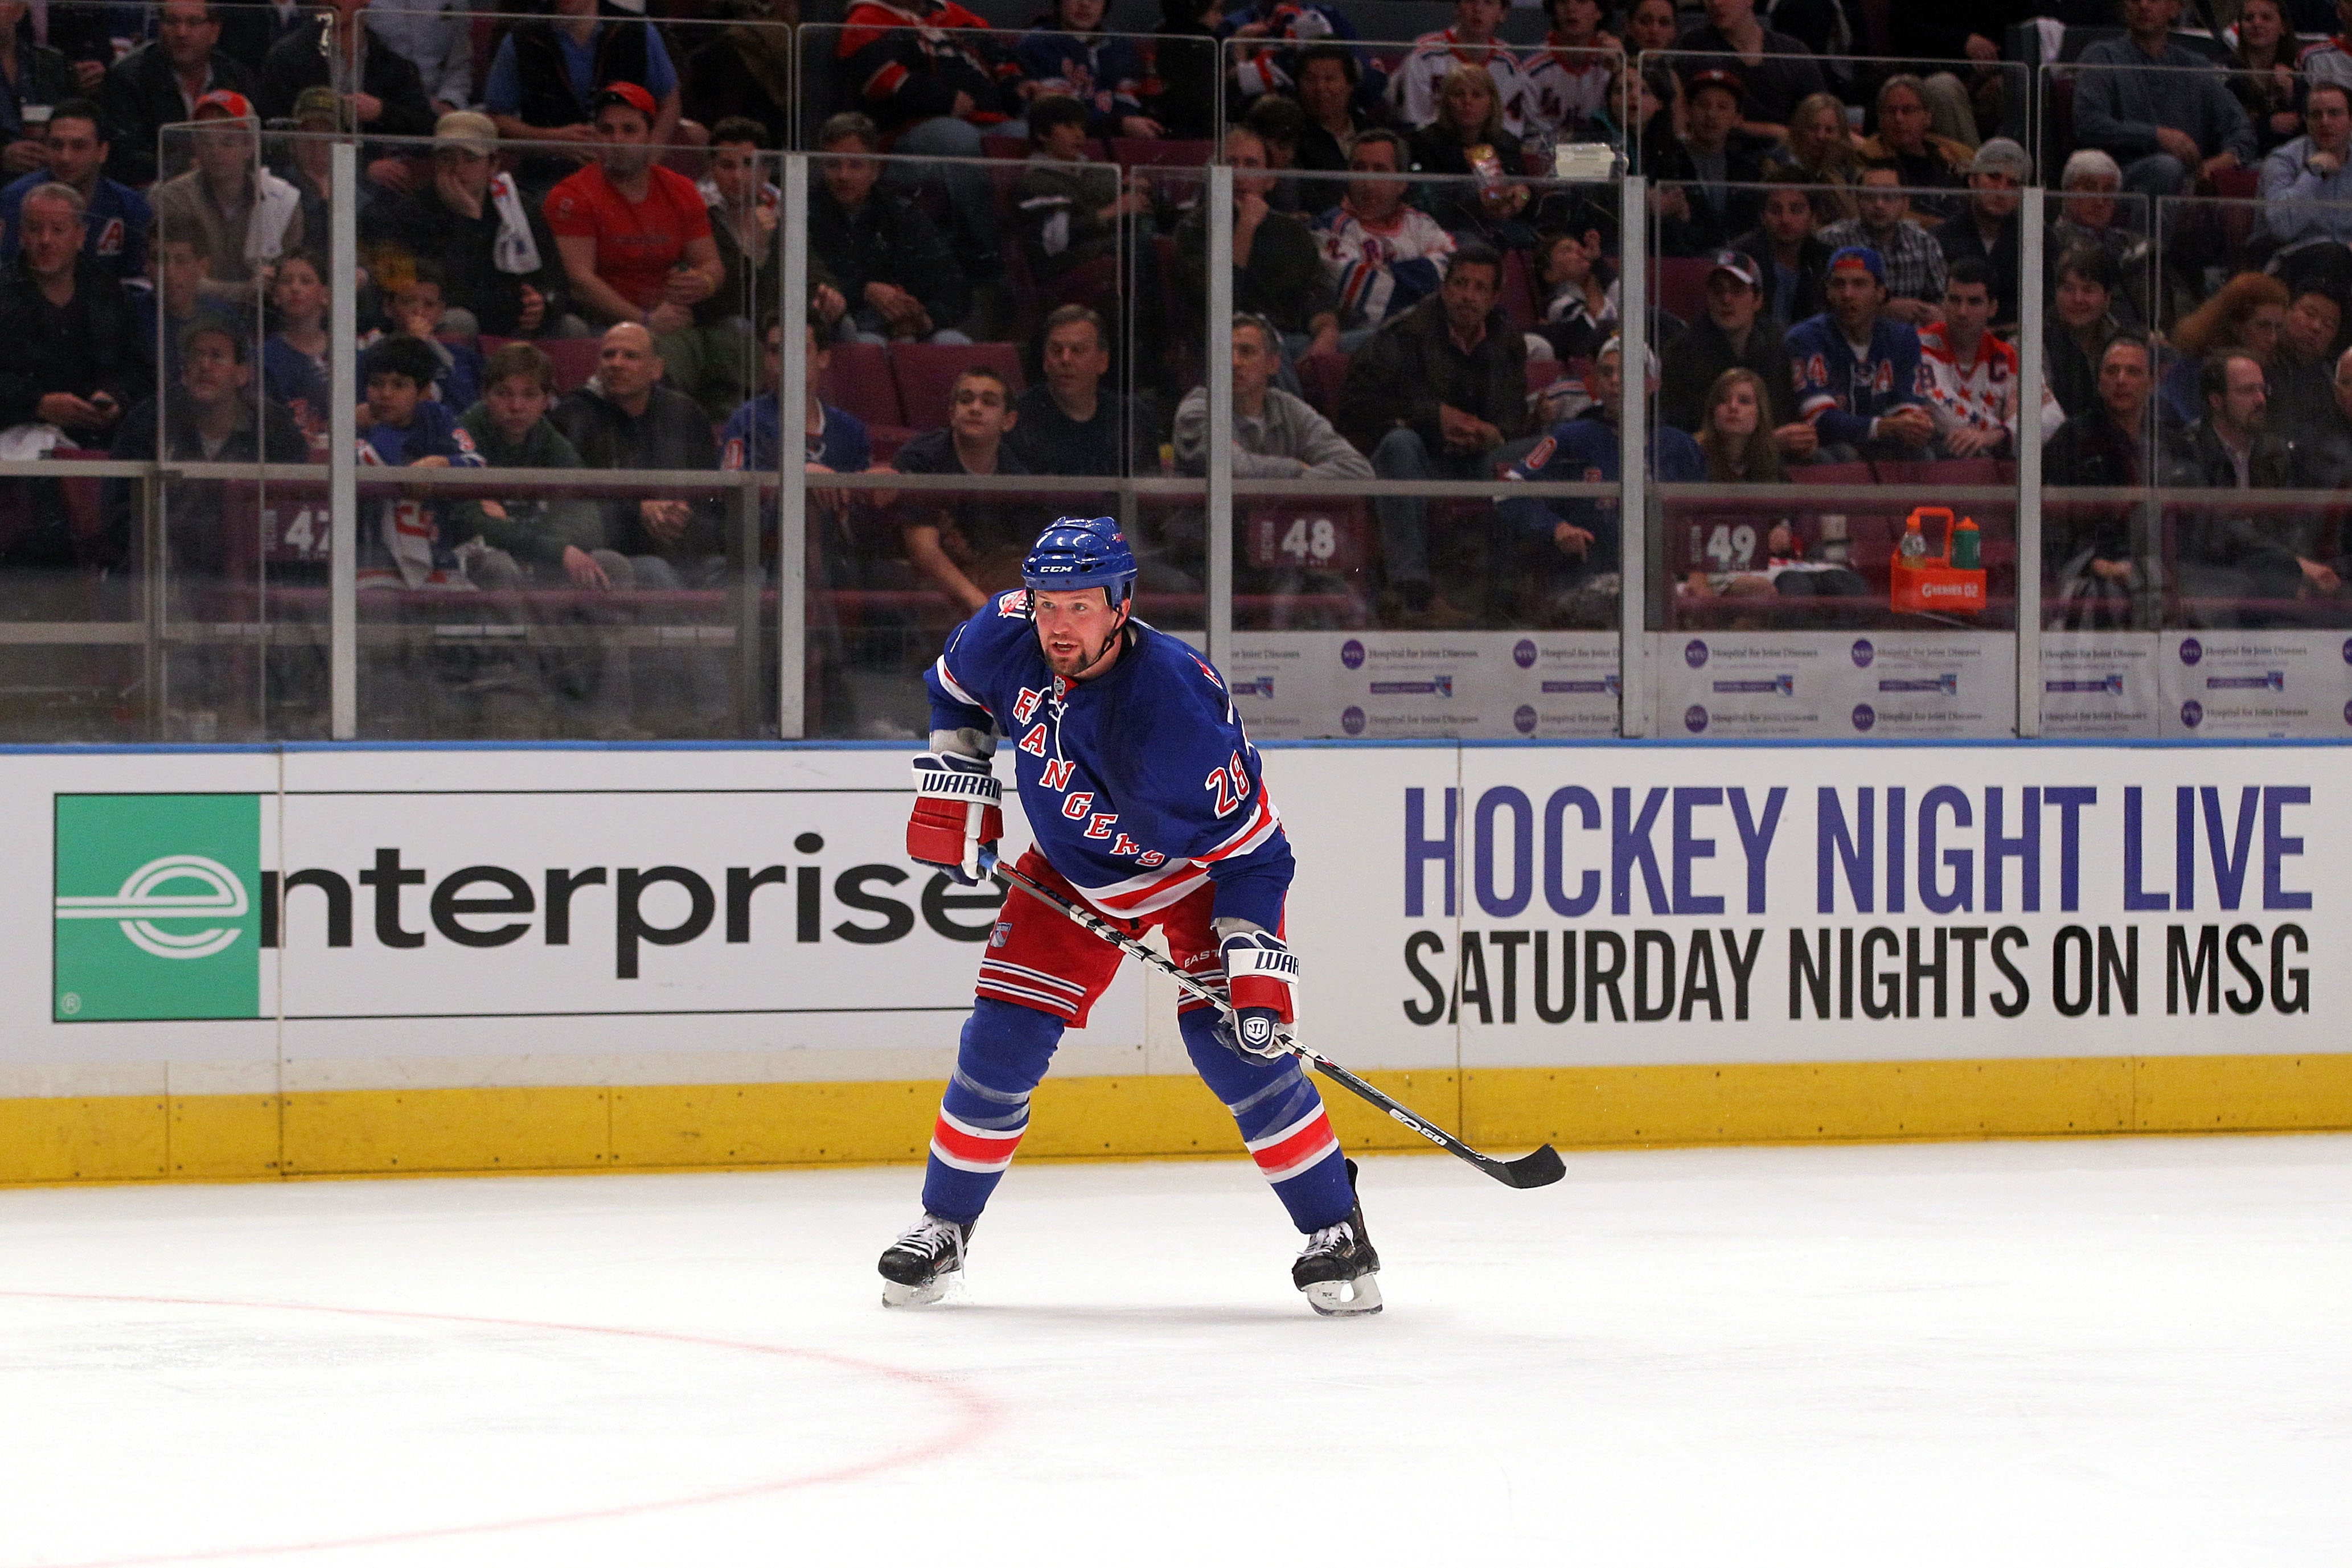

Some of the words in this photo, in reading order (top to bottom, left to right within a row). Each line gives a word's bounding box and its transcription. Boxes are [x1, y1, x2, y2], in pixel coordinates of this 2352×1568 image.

[96, 217, 124, 256] A
[1282, 519, 1336, 560] 48
[1706, 524, 1757, 563] 49
[1013, 687, 1166, 867] RANGERS
[1204, 749, 1250, 819] 28
[1405, 785, 1788, 918] HOCKEY
[1817, 785, 2097, 914] NIGHT
[2124, 786, 2313, 911] LIVE
[57, 832, 1005, 979] enterprise
[1403, 928, 1764, 1025] SATURDAY
[1789, 925, 2030, 1020] NIGHTS
[2053, 925, 2138, 1017] ON
[2166, 923, 2310, 1016] MSG
